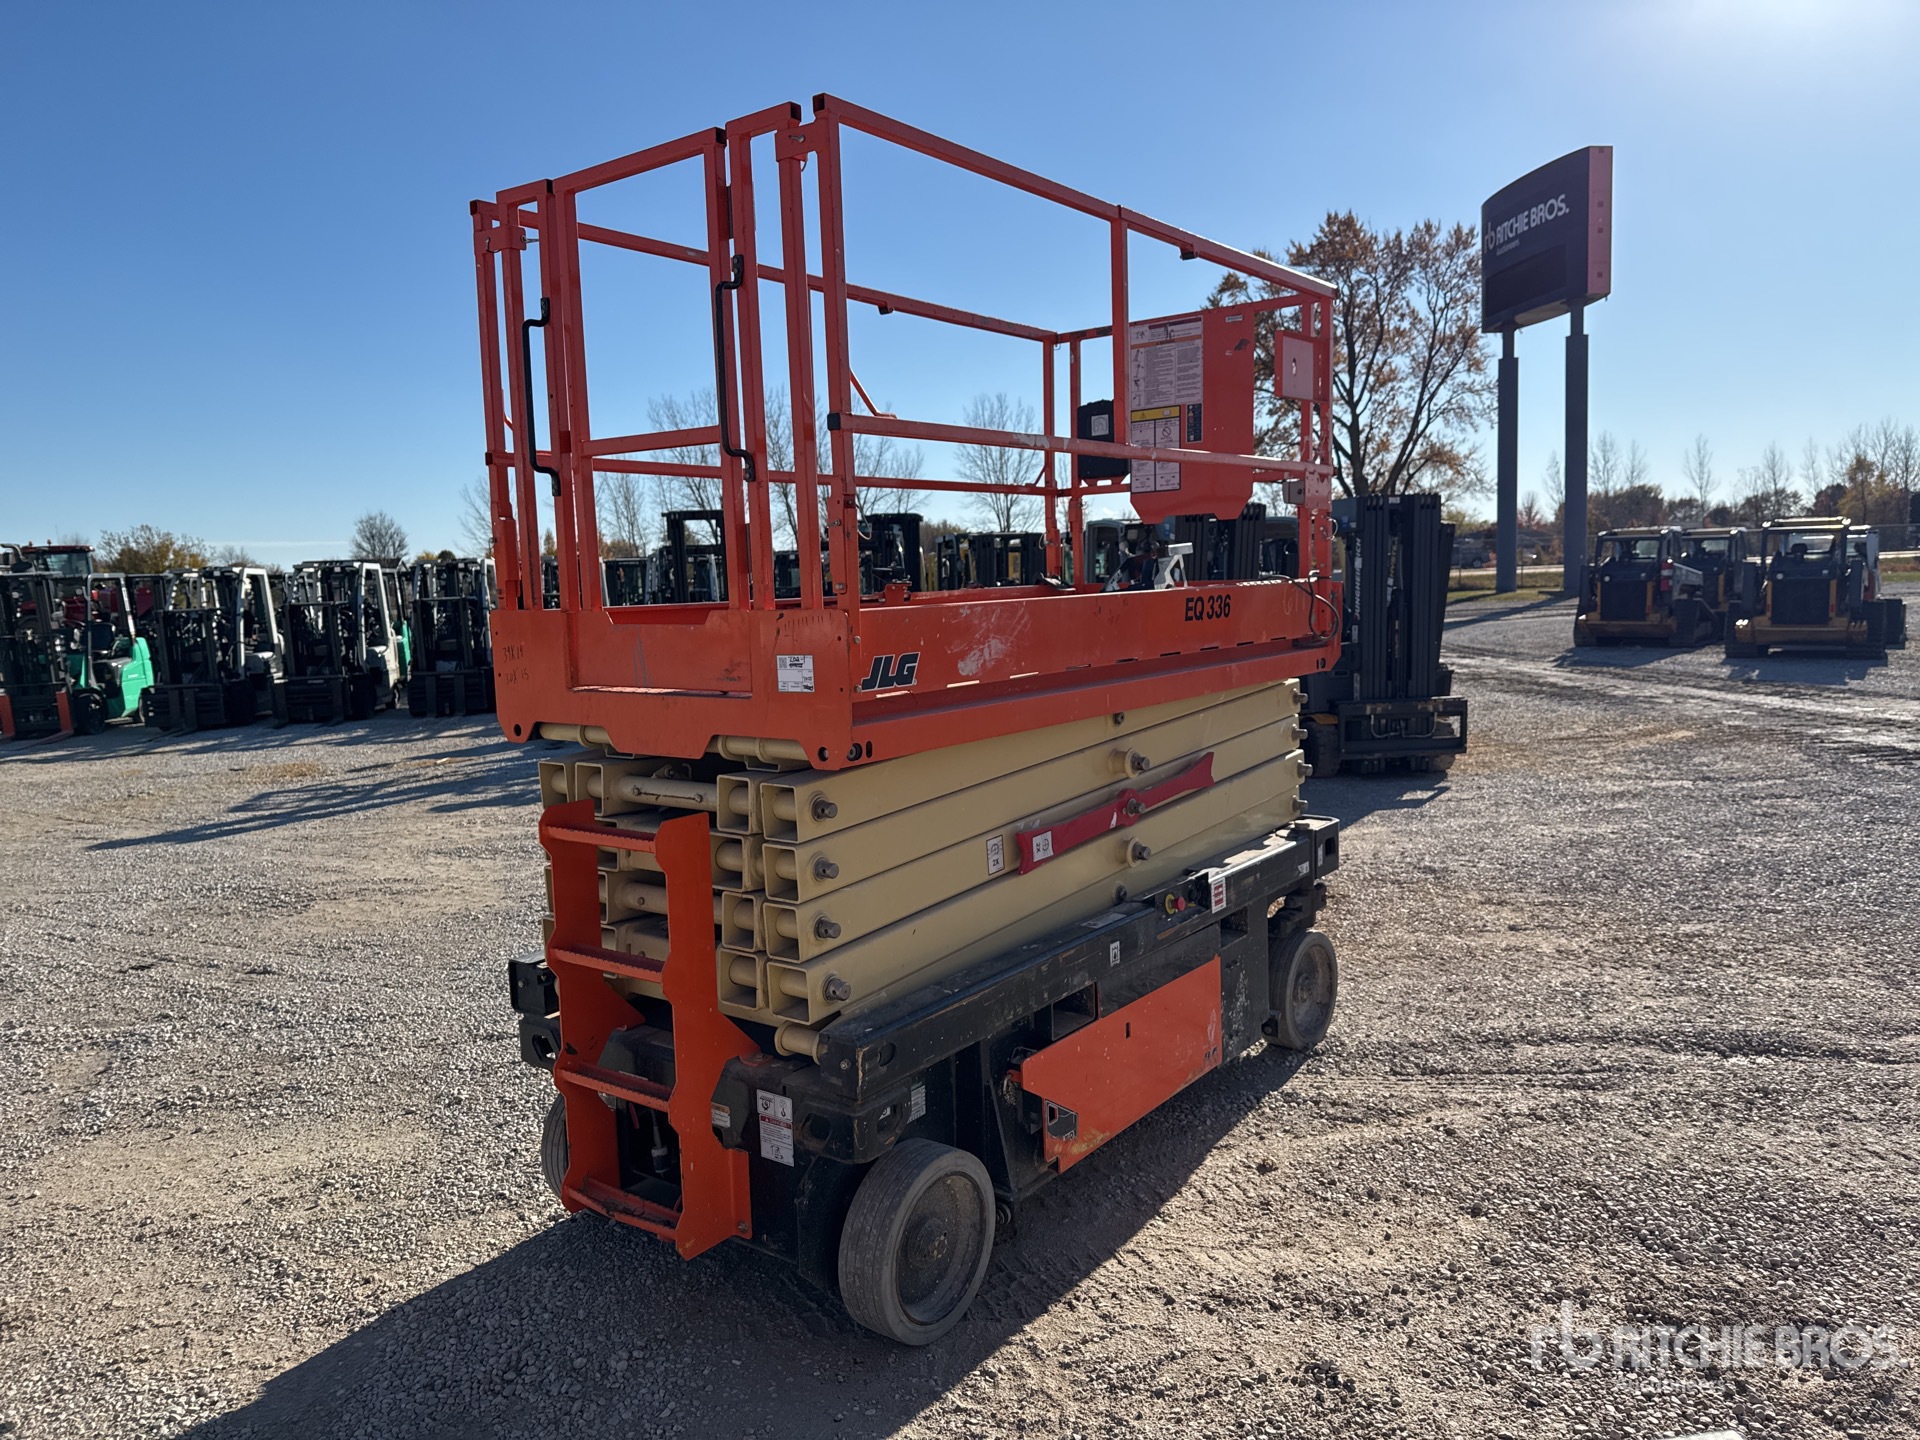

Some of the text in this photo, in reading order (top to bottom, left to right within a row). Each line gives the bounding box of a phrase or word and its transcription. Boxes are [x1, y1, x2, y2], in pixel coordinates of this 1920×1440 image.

[1496, 210, 1529, 246] RITCHIE
[1530, 194, 1570, 228] BROS.
[1353, 538, 1362, 620] JUNGHEIICH
[1185, 594, 1231, 621] EQ 336
[861, 652, 920, 692] JLG
